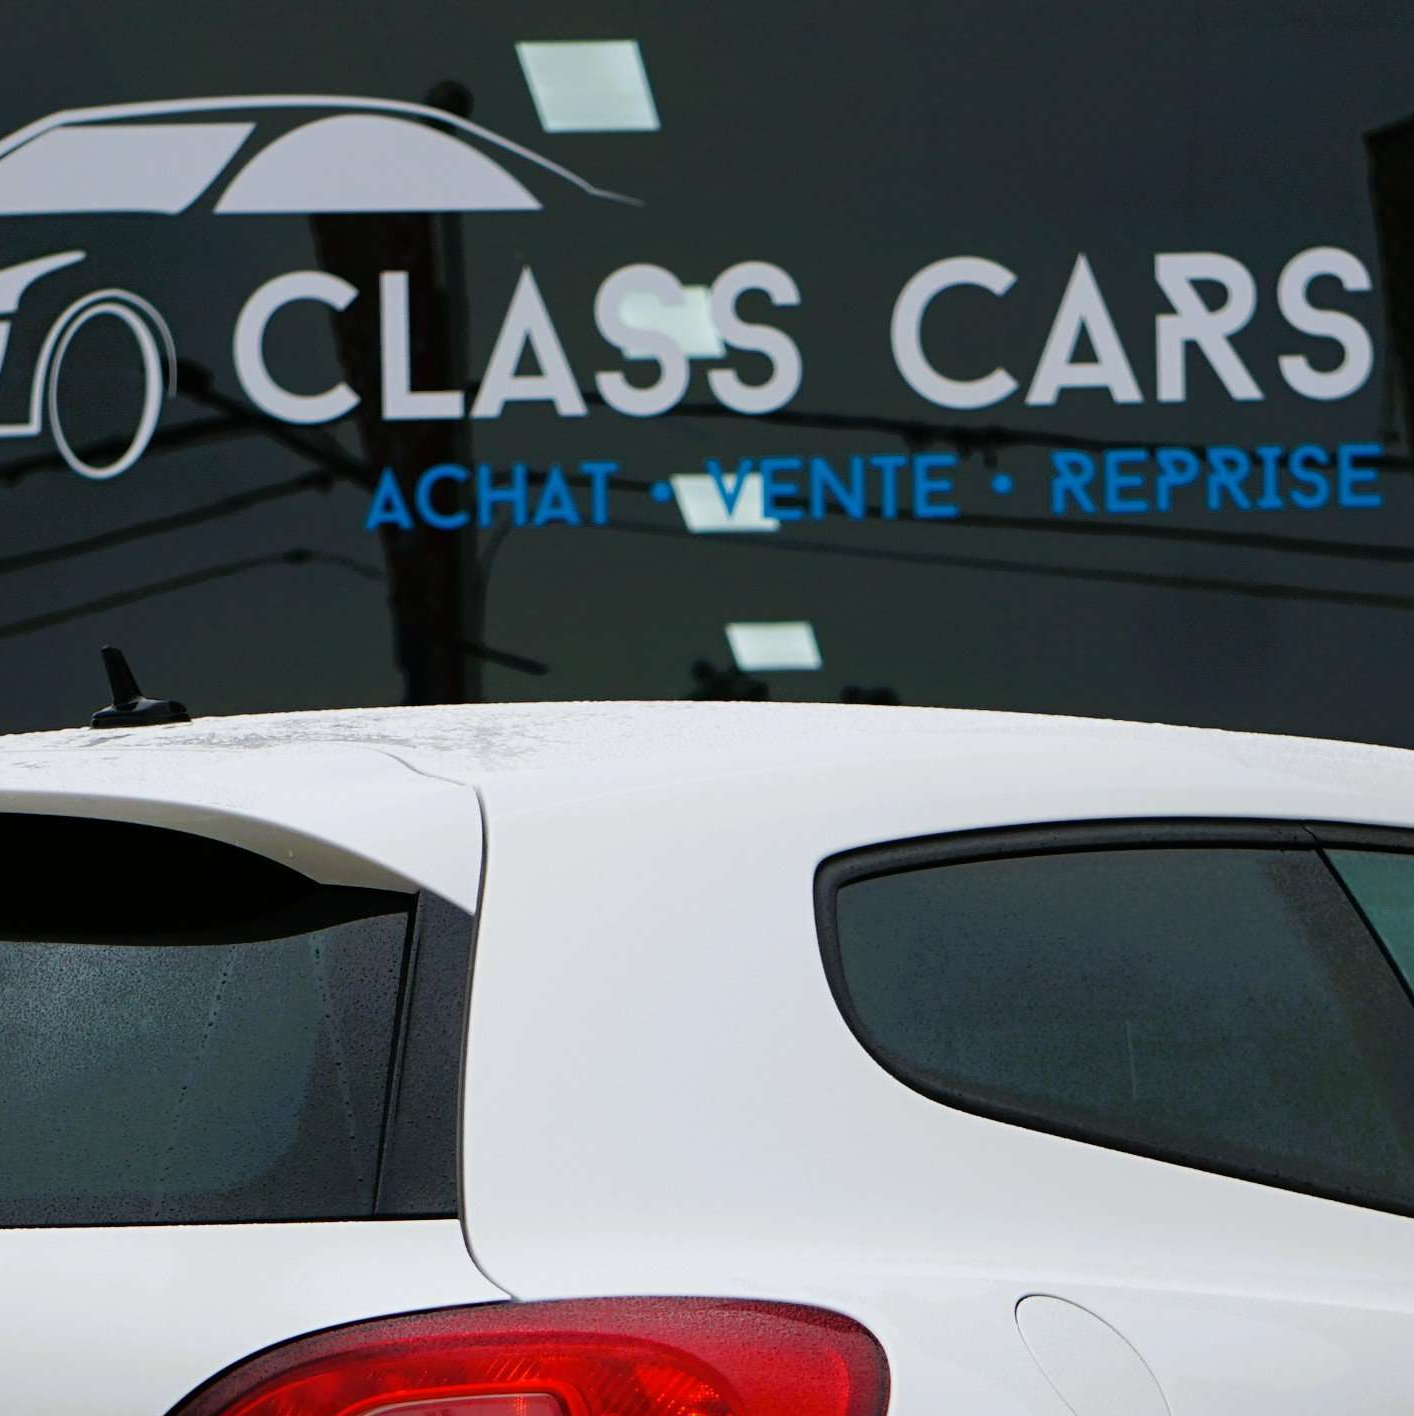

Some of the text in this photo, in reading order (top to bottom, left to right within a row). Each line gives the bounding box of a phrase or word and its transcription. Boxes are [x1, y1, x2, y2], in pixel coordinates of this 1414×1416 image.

[233, 246, 1373, 423] CLASS CARS
[362, 441, 1385, 533] ACHAT VENTE REPRISE
